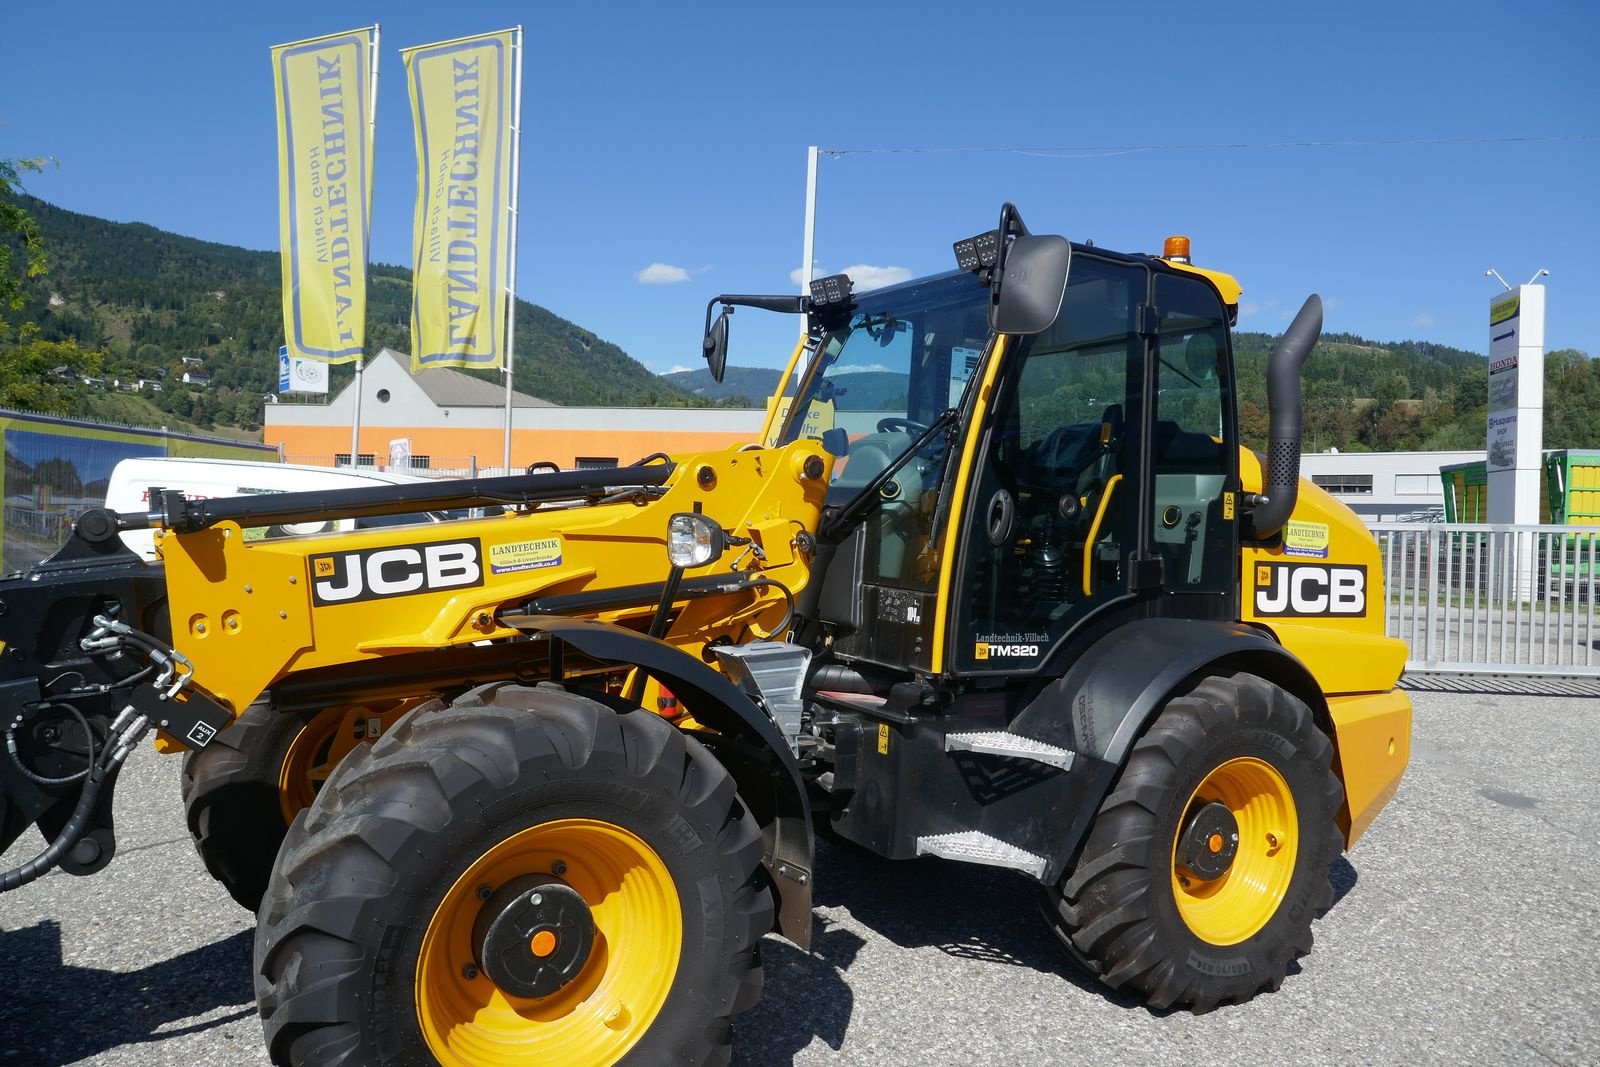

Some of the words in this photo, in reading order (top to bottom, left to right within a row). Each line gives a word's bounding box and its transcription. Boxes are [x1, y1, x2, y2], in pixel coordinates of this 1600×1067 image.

[1490, 355, 1518, 370] HONDA
[782, 408, 820, 419] Dke
[801, 423, 819, 434] Ihr
[1286, 527, 1326, 540] LANDTECHNIK
[492, 539, 558, 556] LANDTECHNIK
[316, 543, 480, 601] JCB
[496, 561, 558, 574] www.landtechnik.co.at
[1256, 566, 1365, 613] JCB
[975, 633, 1049, 643] Landtechnik-Villach
[988, 645, 1039, 656] TM320
[196, 732, 204, 740] 2
[197, 726, 212, 736] AUX
